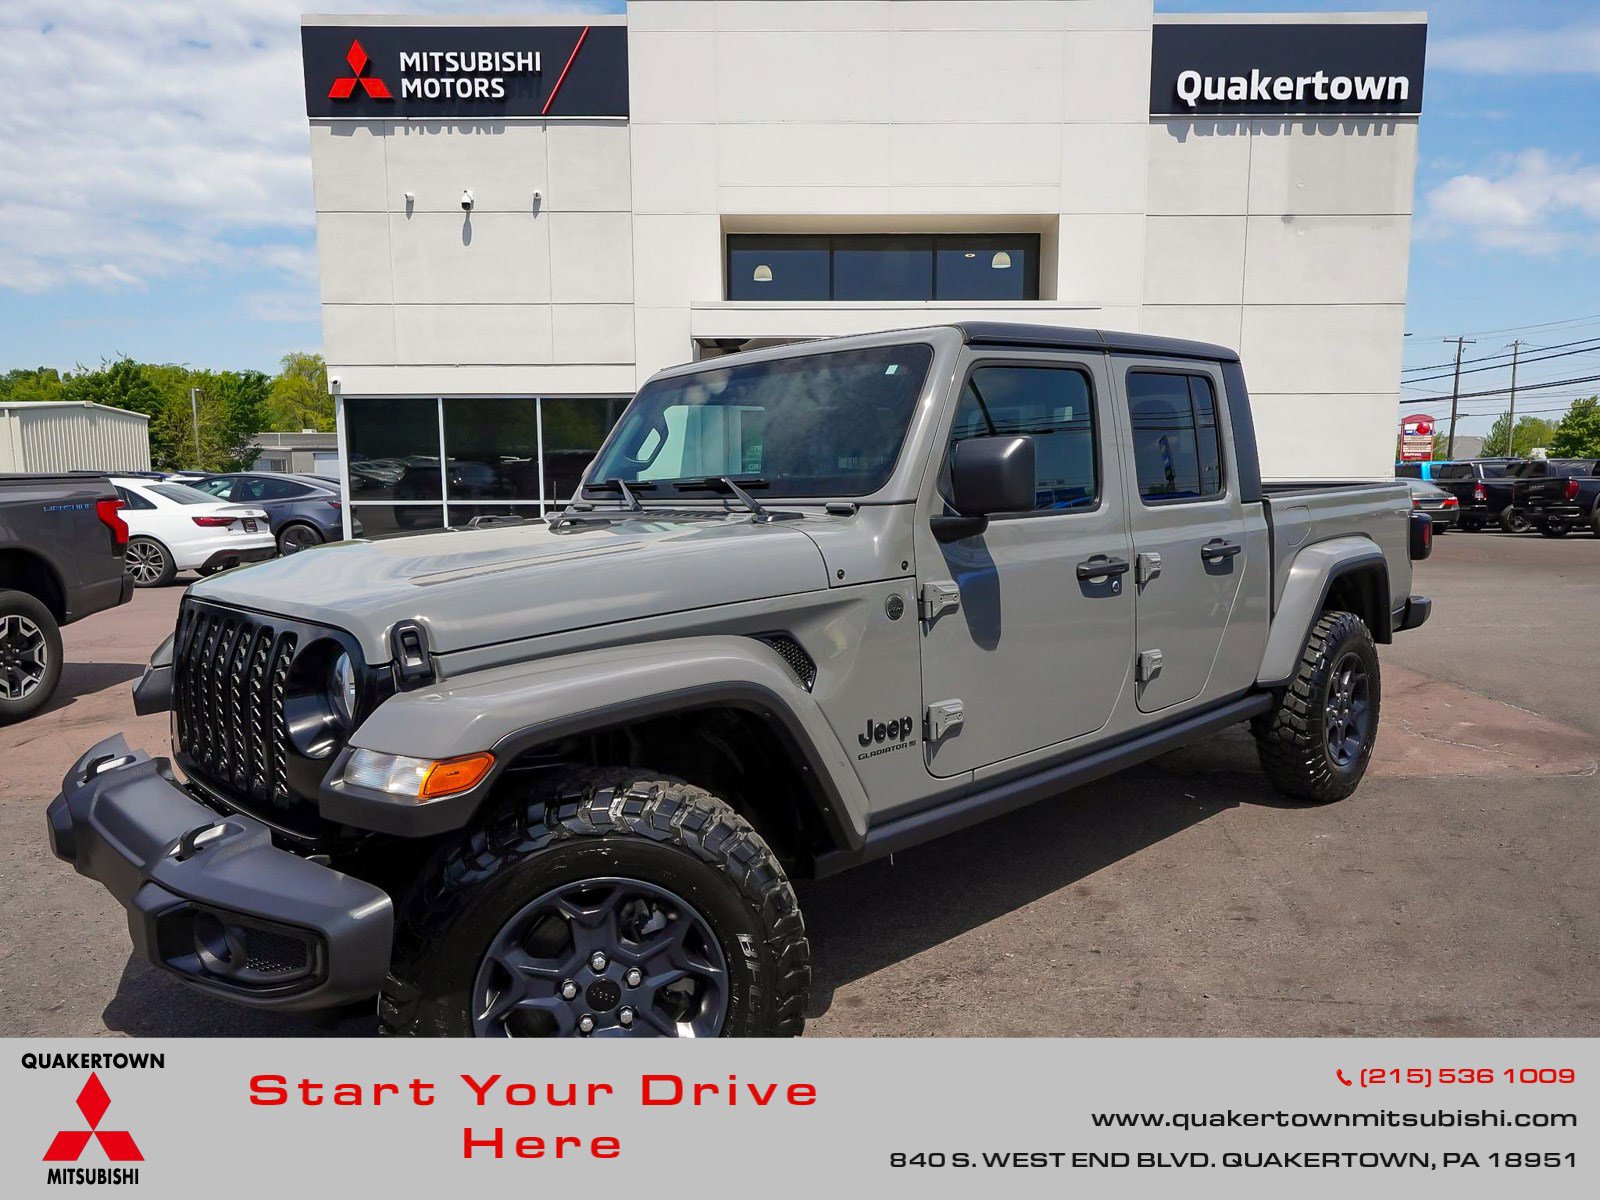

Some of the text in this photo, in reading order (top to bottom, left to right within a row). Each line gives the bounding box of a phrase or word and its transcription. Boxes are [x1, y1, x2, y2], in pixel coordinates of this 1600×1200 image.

[400, 51, 541, 72] MITSUBISHI
[401, 77, 505, 99] MOTORS
[1176, 68, 1410, 107] Quakertown
[858, 716, 913, 748] Jeep
[857, 742, 908, 761] GLADIATOR
